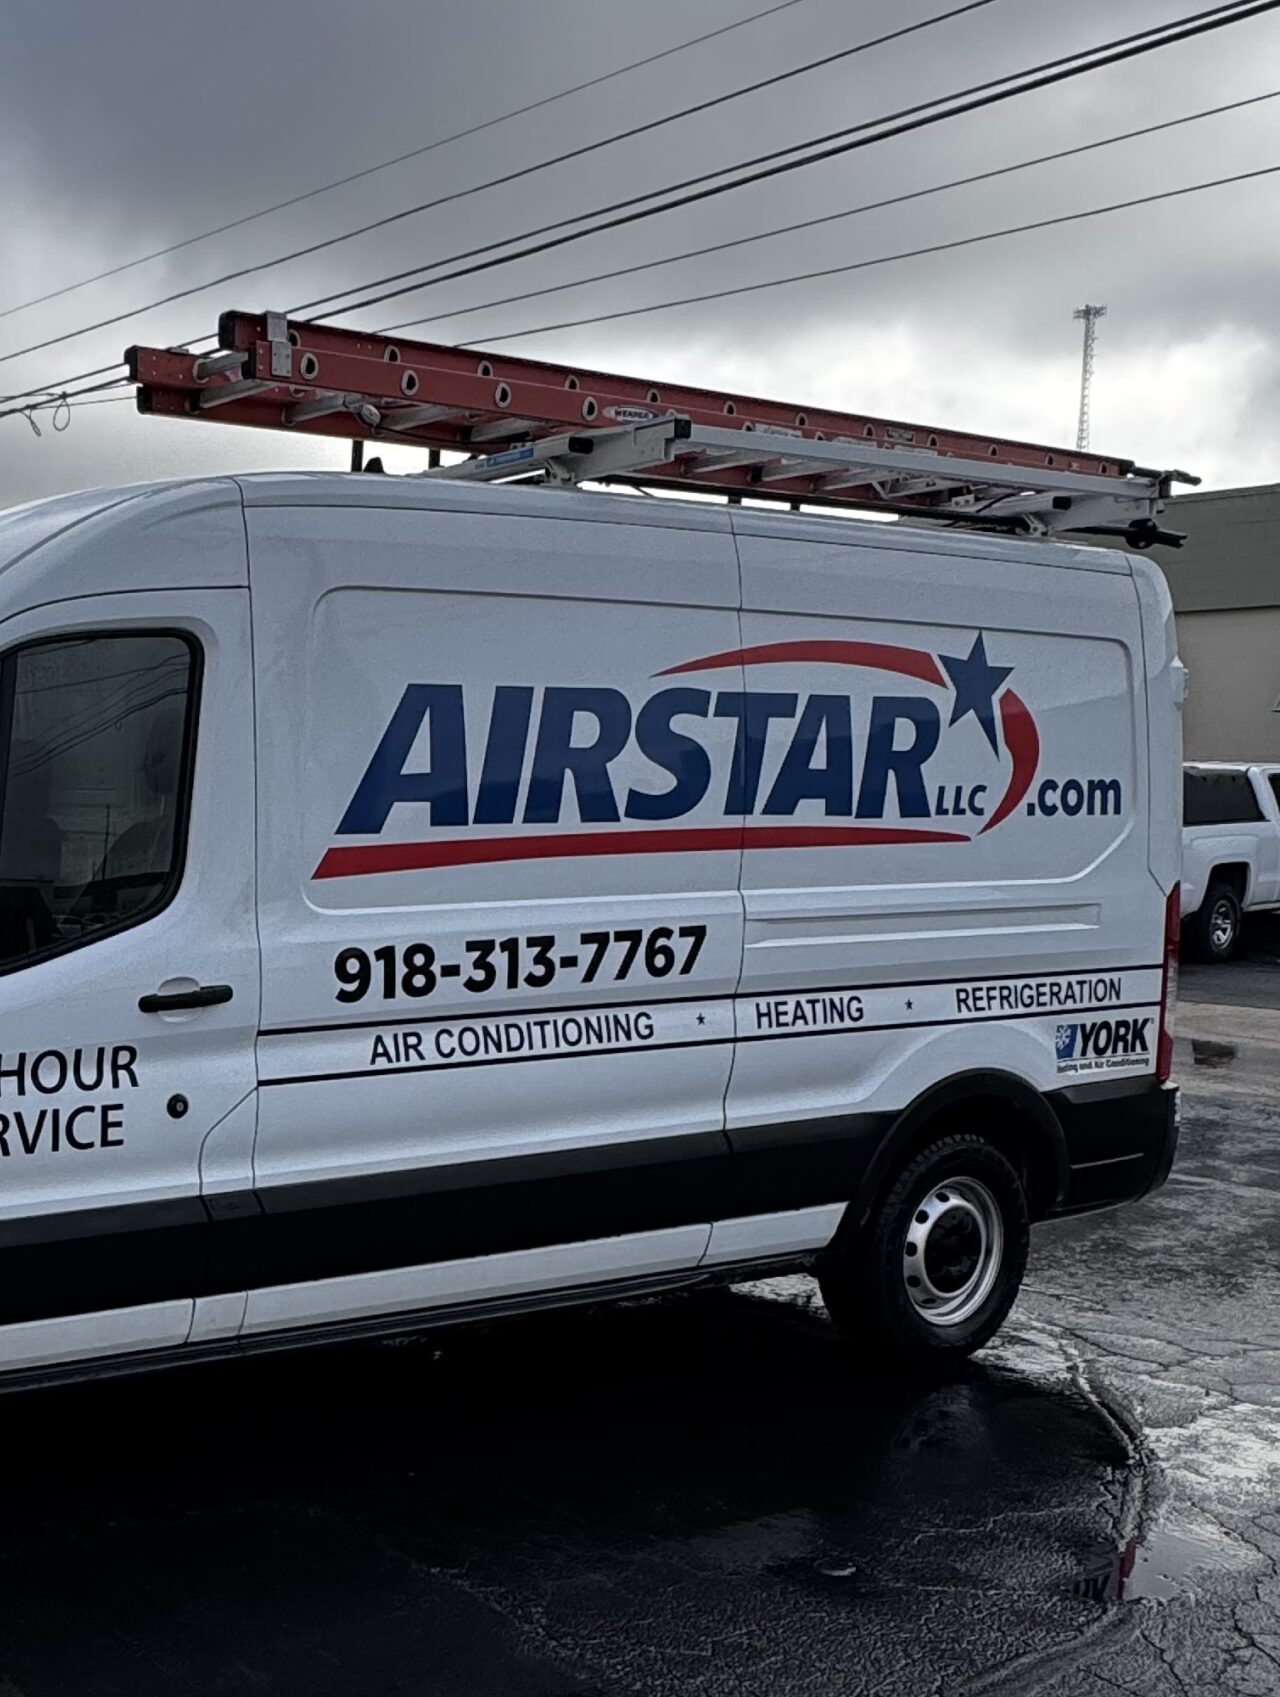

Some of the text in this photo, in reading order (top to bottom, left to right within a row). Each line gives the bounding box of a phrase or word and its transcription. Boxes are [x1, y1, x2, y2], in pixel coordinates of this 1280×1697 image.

[335, 684, 939, 835] AIRSTAR
[936, 785, 986, 817] LLC
[334, 925, 707, 1003] 918-313-7767
[755, 977, 1120, 1029] HEATING REFRIGERATION
[370, 1012, 654, 1065] AIR CONDITIONING
[1080, 1018, 1150, 1057] YORK
